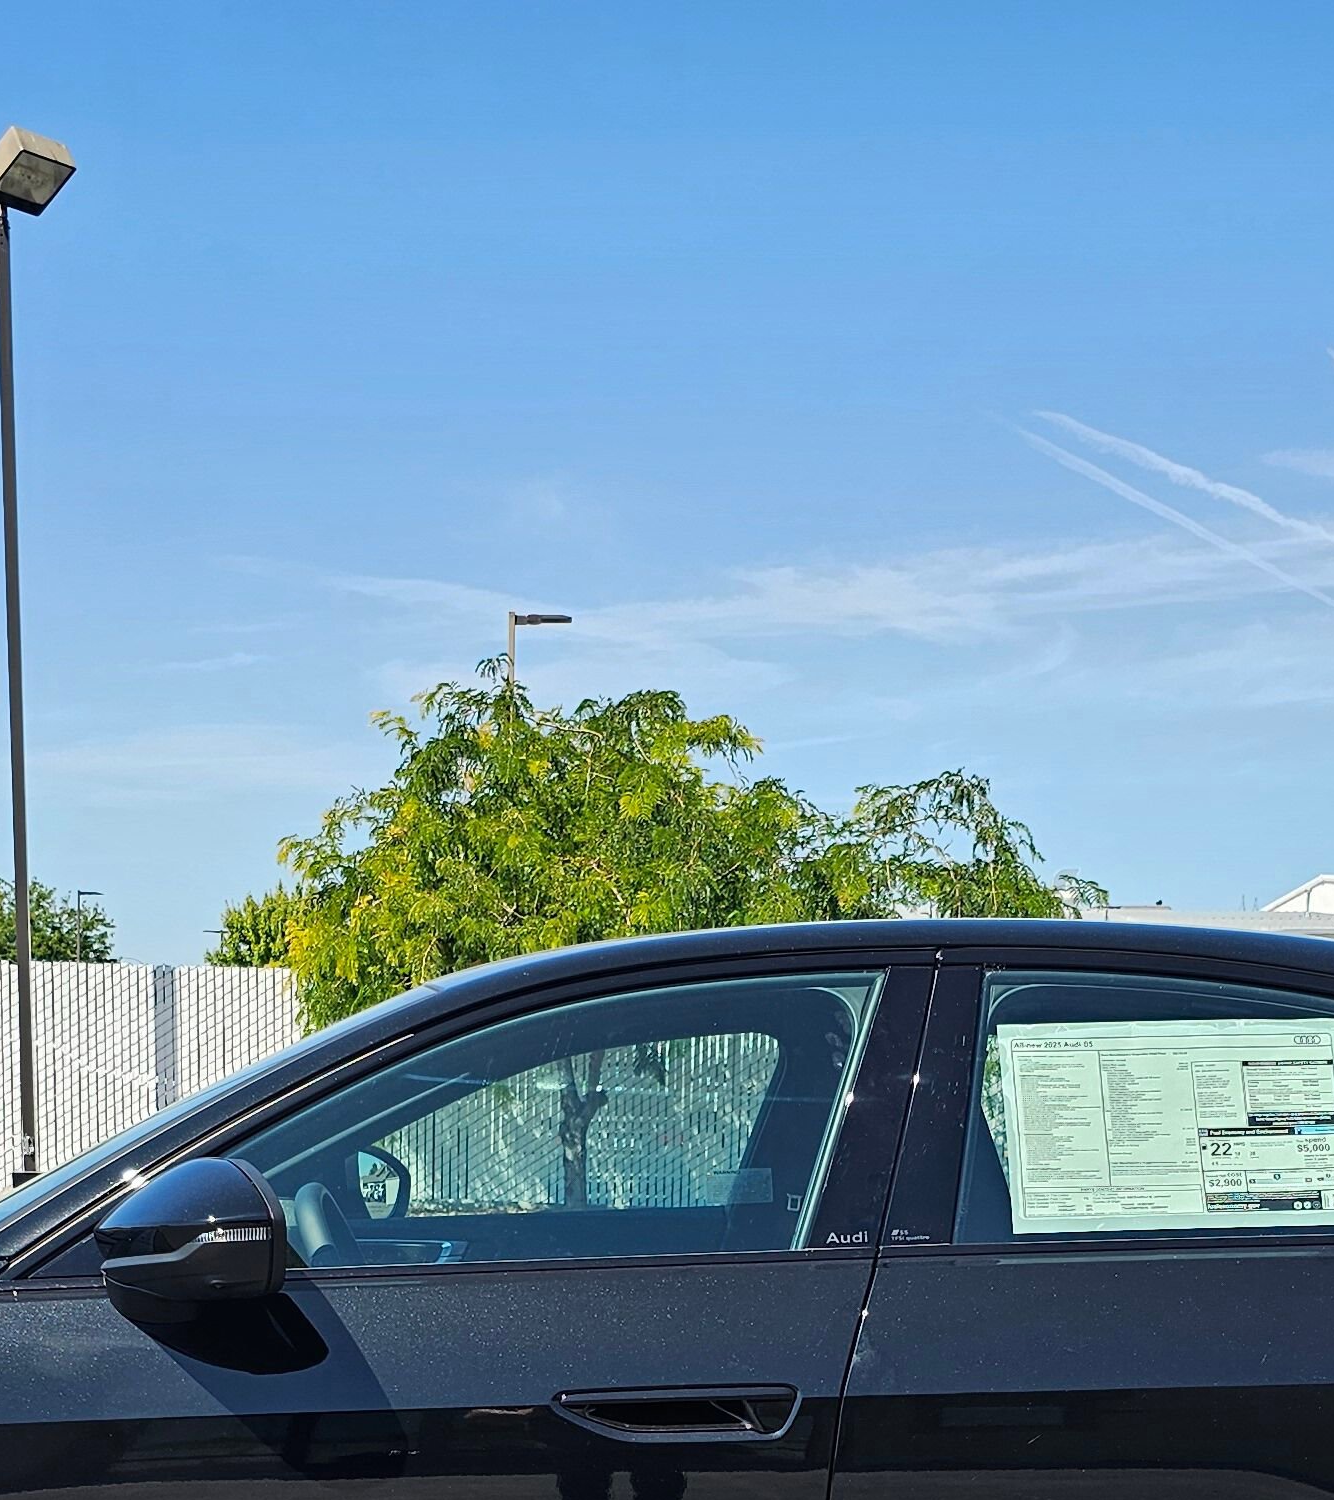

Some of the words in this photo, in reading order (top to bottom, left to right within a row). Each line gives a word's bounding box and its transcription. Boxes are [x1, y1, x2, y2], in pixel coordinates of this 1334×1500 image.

[1210, 1142, 1233, 1157] 22
[1297, 1143, 1331, 1153] $5,000
[1208, 1178, 1243, 1188] $2,900
[826, 1231, 869, 1244] Audi
